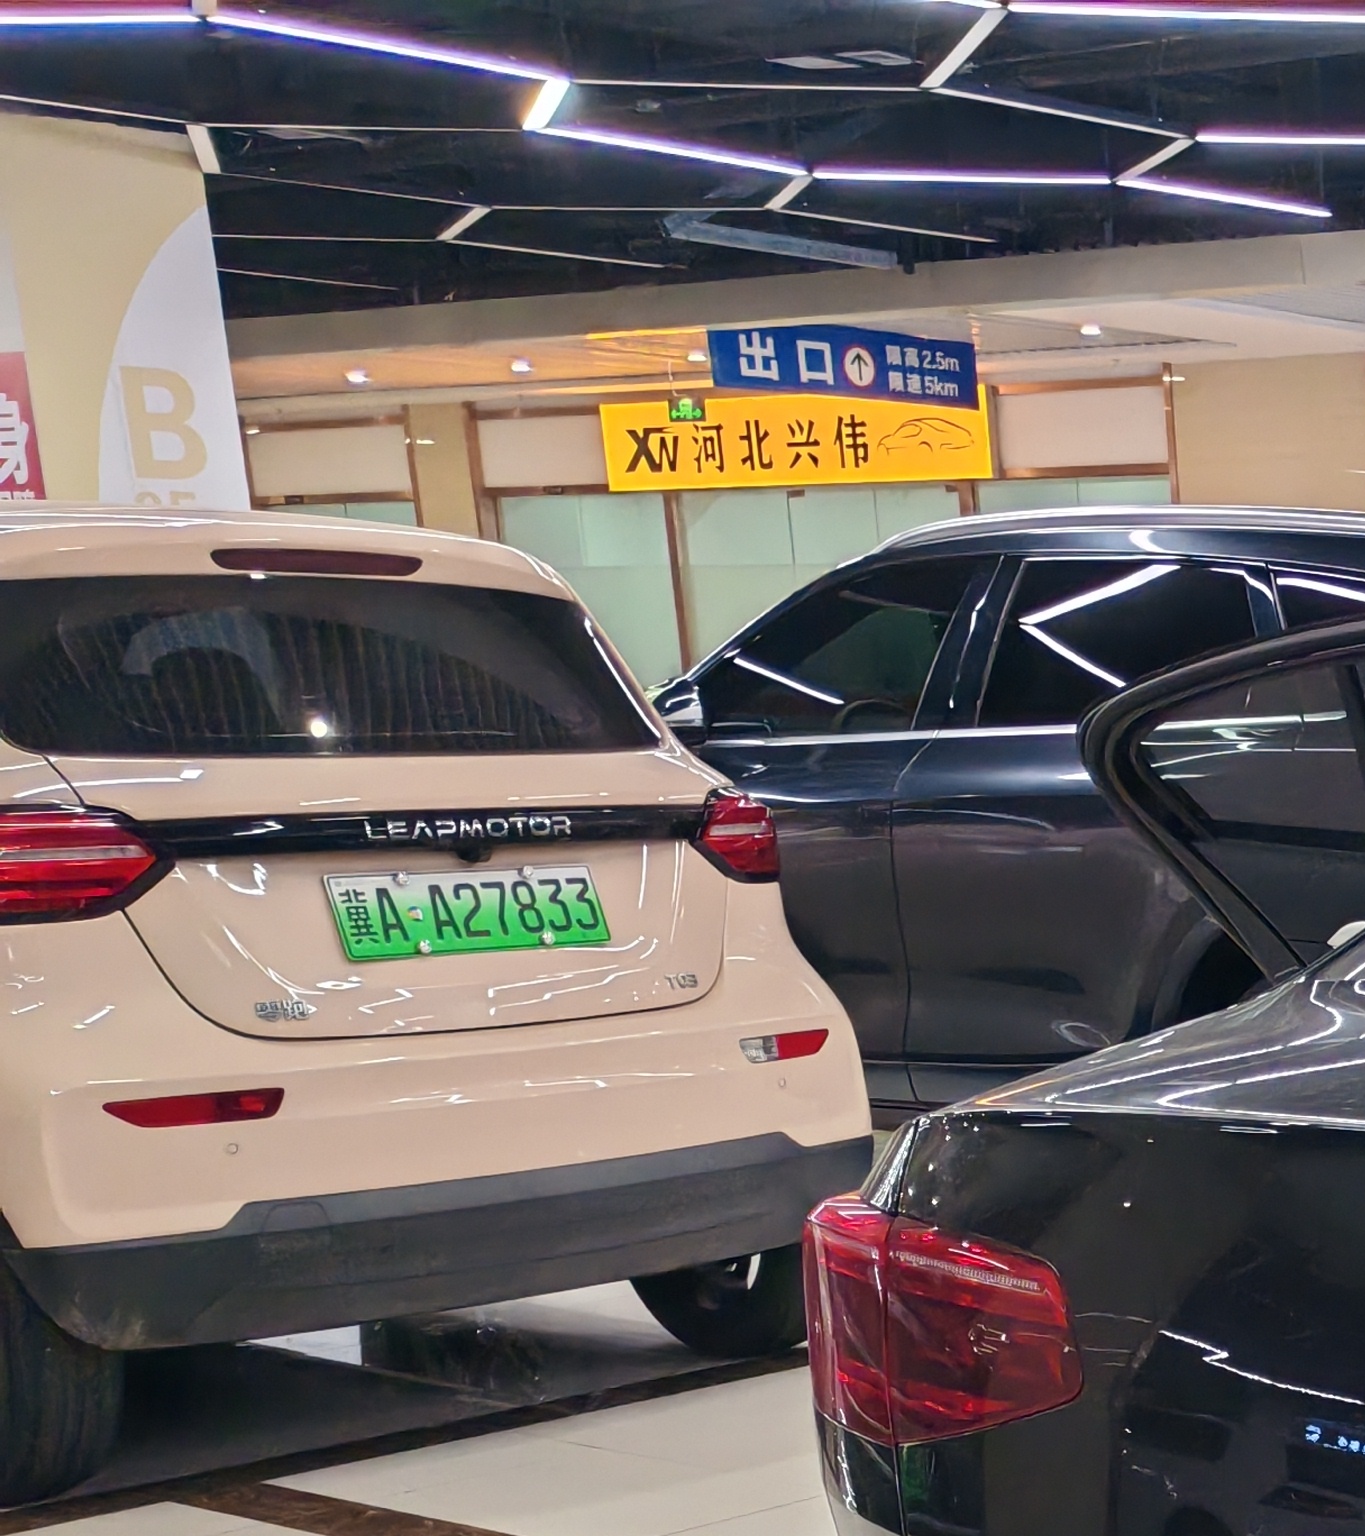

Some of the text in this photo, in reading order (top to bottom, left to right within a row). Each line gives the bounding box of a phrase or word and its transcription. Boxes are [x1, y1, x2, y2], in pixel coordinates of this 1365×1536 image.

[738, 331, 835, 386] 出口
[119, 366, 208, 480] B
[691, 413, 870, 474] 河北兴伟
[364, 814, 573, 840] LEAPMOTOR
